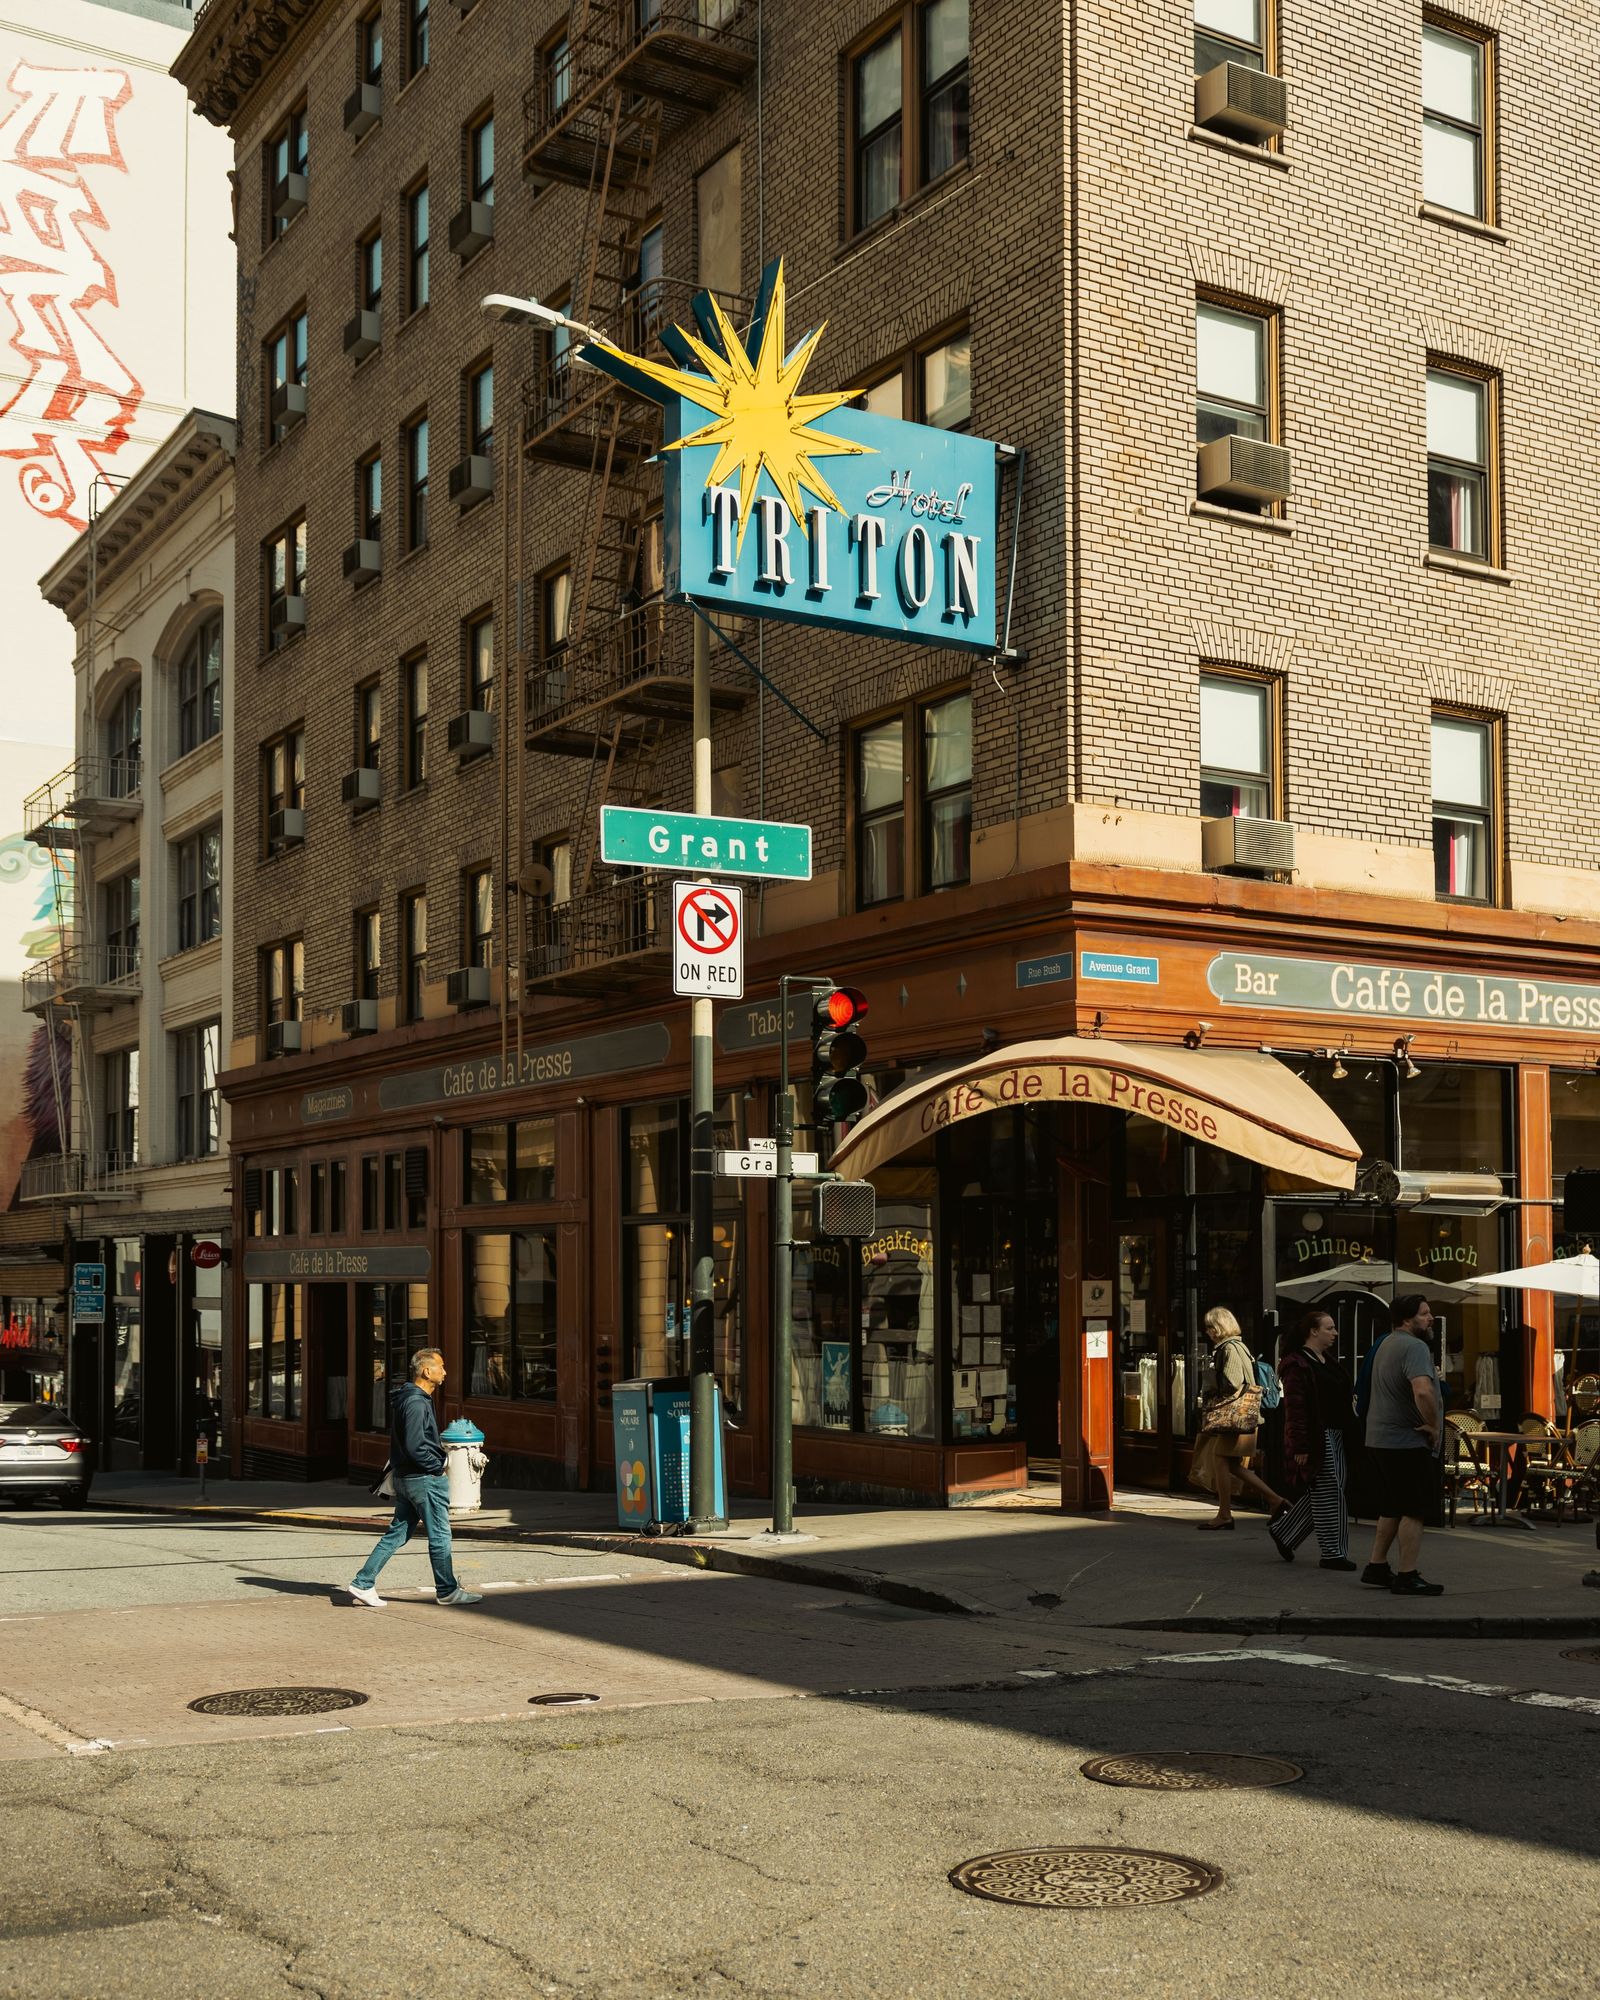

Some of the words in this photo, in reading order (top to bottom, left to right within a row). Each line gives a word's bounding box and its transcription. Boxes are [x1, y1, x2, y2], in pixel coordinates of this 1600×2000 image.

[866, 470, 973, 520] Hotel
[706, 486, 981, 618] TRITON
[649, 825, 769, 863] Grant
[680, 962, 701, 981] ON
[708, 964, 737, 983] RED
[1028, 967, 1041, 979] Rue
[1043, 963, 1061, 976] Bush
[1089, 961, 1123, 973] Avenue
[1126, 963, 1150, 976] Grant
[1234, 963, 1279, 996] Bar
[1331, 965, 1411, 1013] Café
[1424, 975, 1465, 1018] de
[1476, 979, 1508, 1022] la
[748, 1010, 795, 1037] Tabac
[479, 1061, 497, 1090] de
[500, 1057, 516, 1087] a
[306, 1094, 346, 1116] Magazines
[921, 1082, 984, 1134] Café
[1000, 1070, 1043, 1099] de
[1058, 1067, 1092, 1098] la
[1108, 1071, 1218, 1140] Presse
[740, 1157, 793, 1171] Gra
[197, 1248, 220, 1260] Leica
[1294, 1234, 1374, 1264] Dinner
[1416, 1244, 1478, 1267] Lunch
[76, 1266, 88, 1274] Pay
[312, 1251, 323, 1274] de
[325, 1251, 334, 1273] la
[336, 1250, 368, 1273] Presse
[620, 1416, 640, 1426] SQUARE
